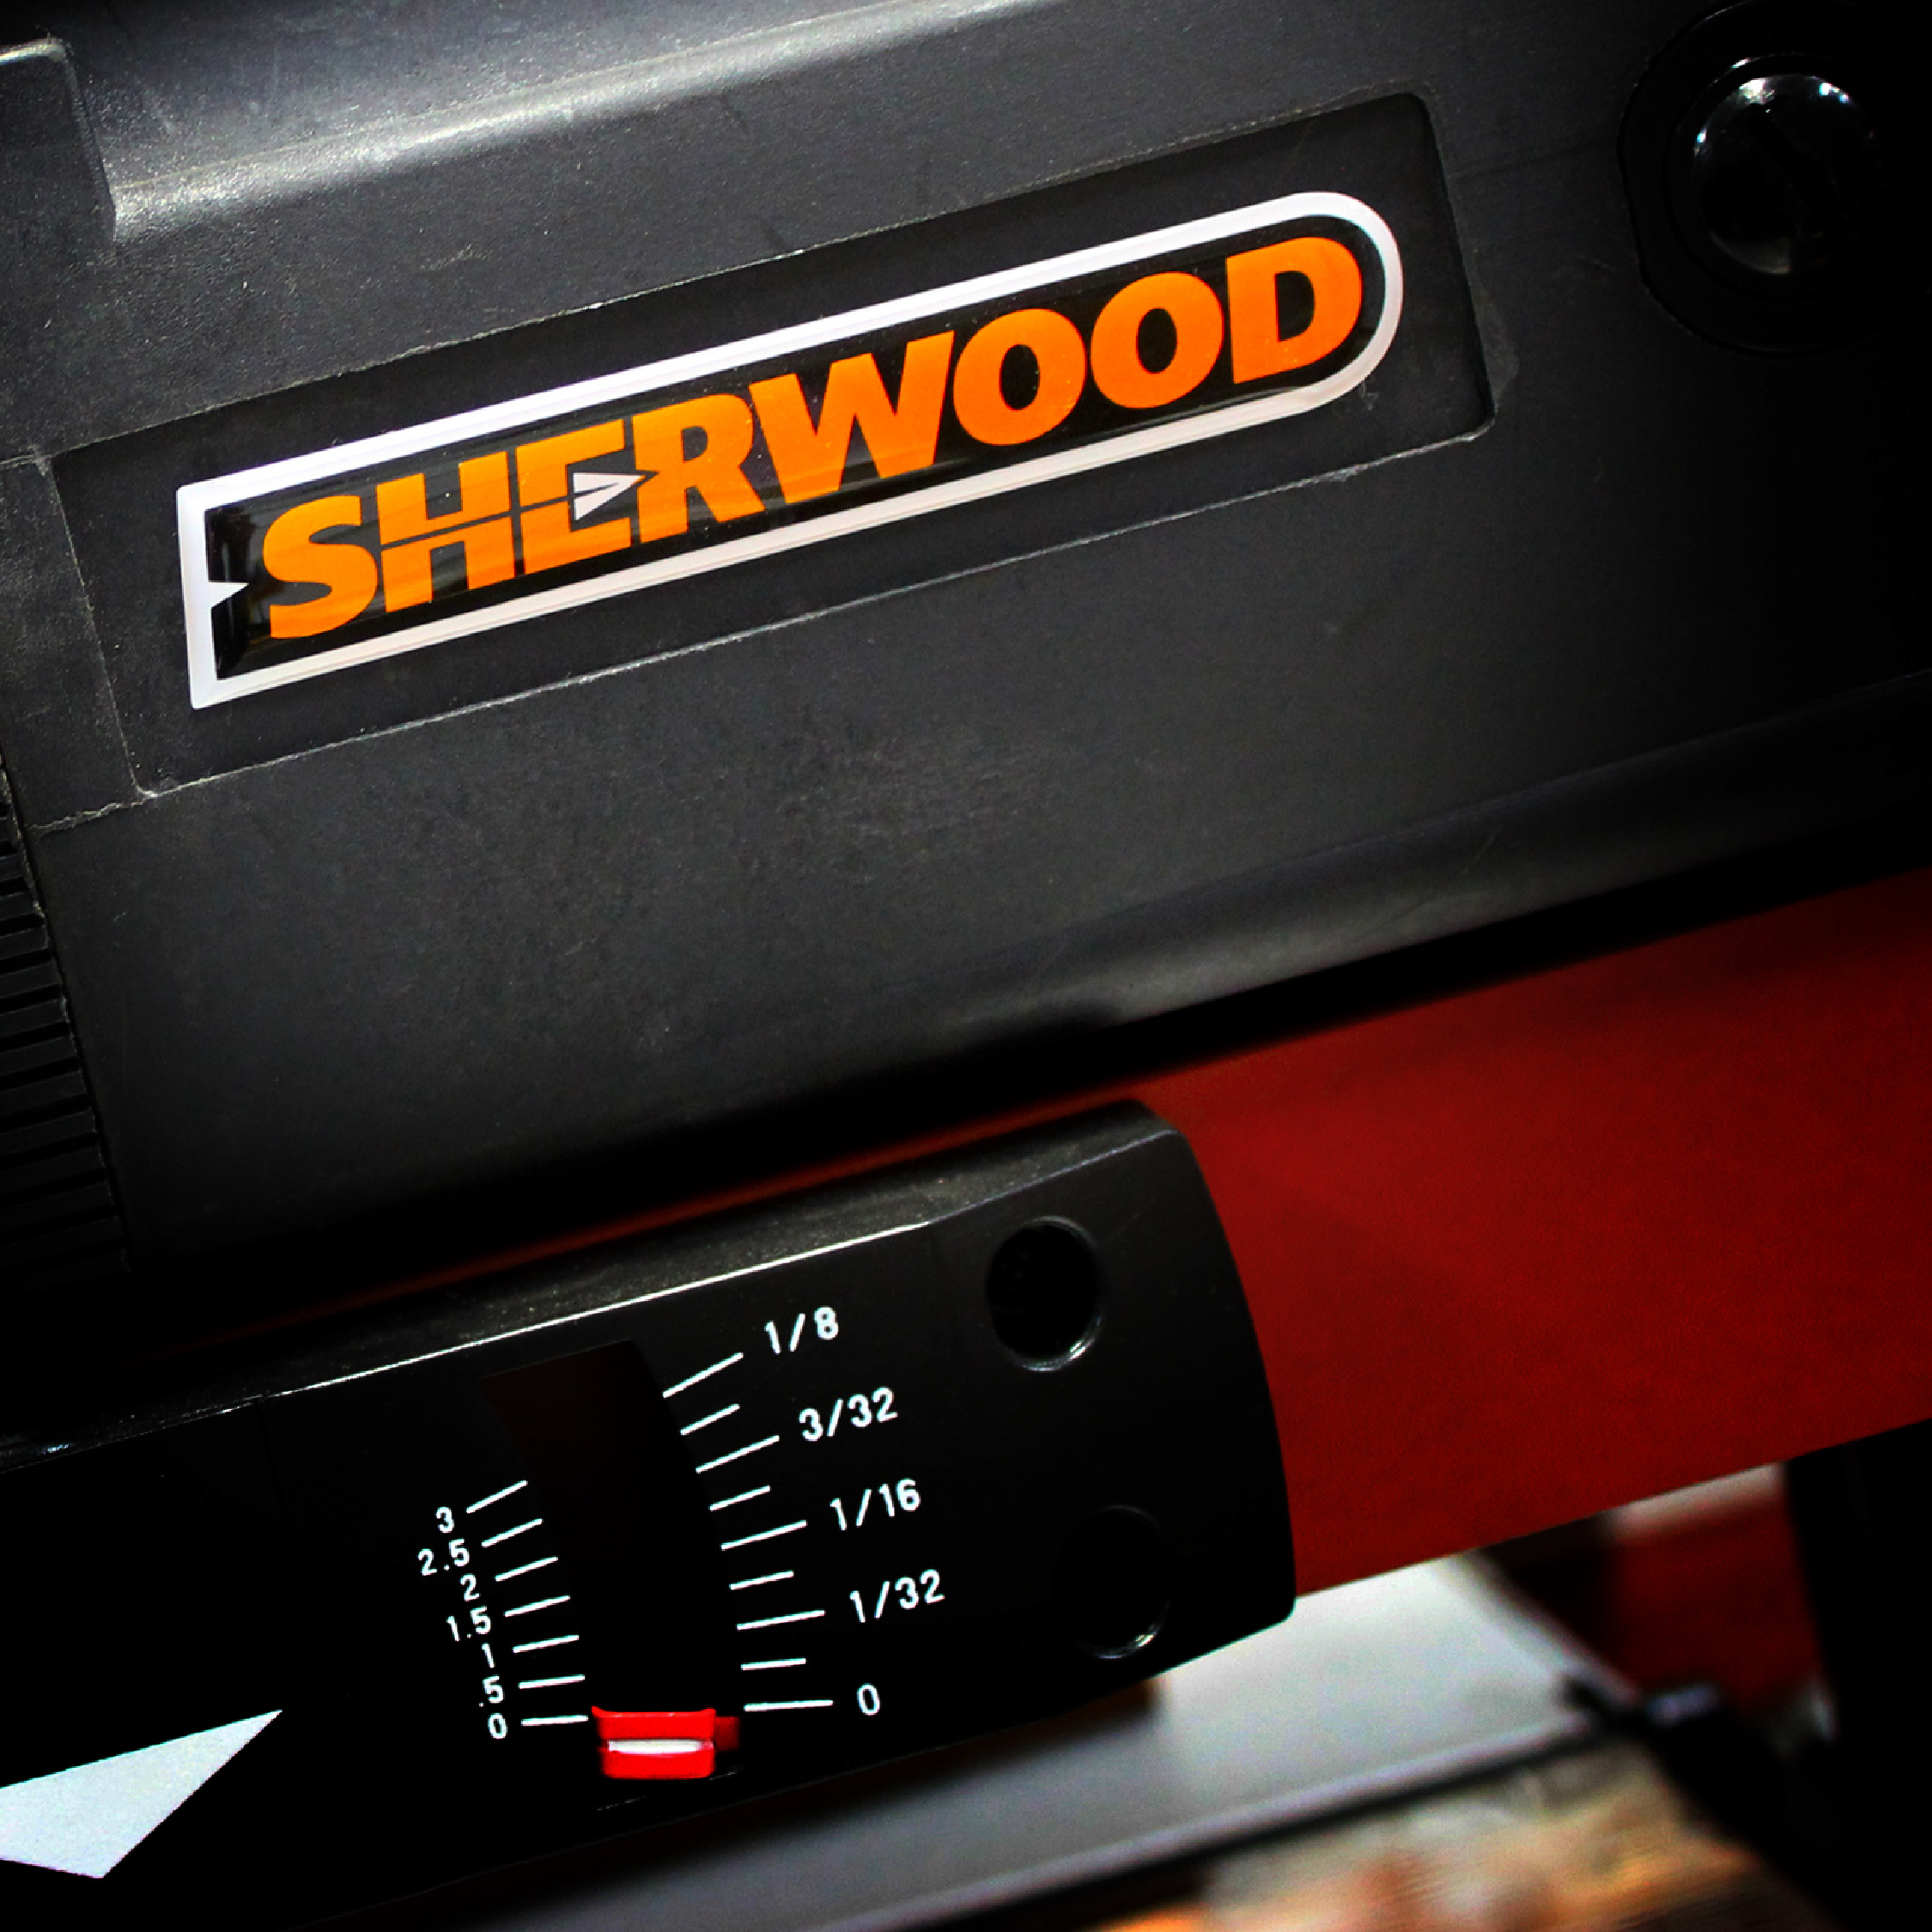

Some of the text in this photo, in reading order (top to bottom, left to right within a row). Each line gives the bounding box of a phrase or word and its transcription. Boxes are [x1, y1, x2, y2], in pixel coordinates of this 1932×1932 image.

[261, 235, 1364, 640] SHERWOOD
[765, 1306, 839, 1354] 1/8
[798, 1387, 898, 1442] 3/32
[435, 1506, 455, 1534] 3
[829, 1479, 921, 1531] 1/16
[417, 1538, 471, 1577] 2.5
[459, 1574, 481, 1602] 2
[849, 1569, 945, 1624] 1/32
[446, 1605, 491, 1642] 1.5
[481, 1643, 495, 1668] 1
[478, 1675, 504, 1708] .5
[856, 1684, 881, 1716] 0
[488, 1712, 508, 1740] 0
